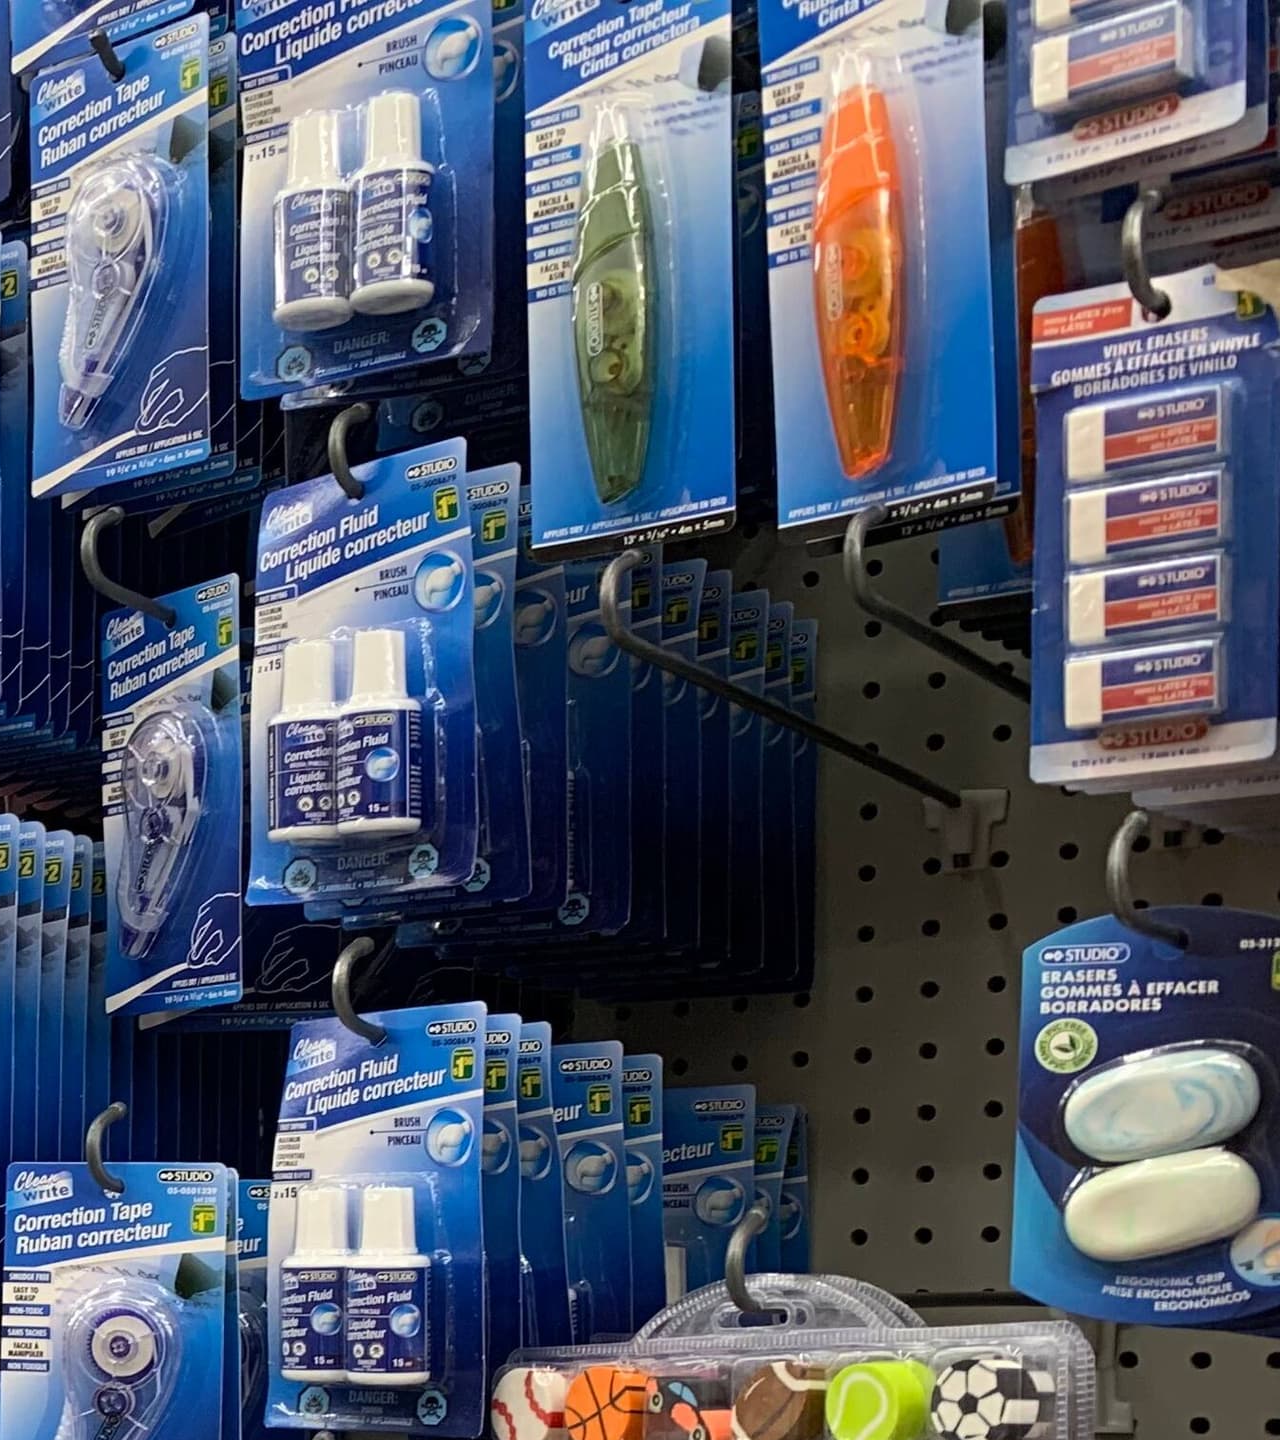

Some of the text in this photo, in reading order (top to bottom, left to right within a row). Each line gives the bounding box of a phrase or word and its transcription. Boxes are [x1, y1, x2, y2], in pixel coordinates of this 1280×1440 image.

[241, 1, 336, 56] Correction
[276, 23, 341, 64] Liquide
[387, 35, 418, 53] BRUSH
[549, 14, 625, 59] Correction
[562, 5, 690, 71] Ruban correcteur
[580, 15, 700, 79] Cinta correctora
[379, 54, 419, 75] PINCEAU
[39, 74, 149, 146] Correction Tape
[40, 90, 166, 169] Ruban correcteur
[1103, 327, 1208, 359] VINYL ERASERS
[1051, 333, 1260, 386] GOMMES VINYLE
[1073, 355, 1238, 399] BORRADORES VINILO
[1157, 397, 1205, 418] STUDIO
[420, 457, 456, 475] STUDIO
[1161, 482, 1208, 502] STUDIO
[260, 505, 378, 571] Correction Fluid
[285, 512, 430, 583] Liquide correcteur
[1158, 567, 1205, 586] STUDIO
[108, 625, 195, 679] Correction Tape
[1154, 653, 1202, 672] STUDIO
[110, 642, 207, 701] Ruban correcteur
[1065, 948, 1120, 963] STUDIO
[1041, 980, 1219, 999] GOMMES EFFACER
[1042, 969, 1117, 984] ERASERS
[1041, 998, 1162, 1014] BORRADORES
[441, 1021, 476, 1034] STUDIO
[285, 1055, 397, 1100] Correction Fluid
[573, 1060, 611, 1072] STUDIO
[305, 1066, 446, 1116] Liquide correcteur
[394, 1116, 421, 1128] BRUSH
[174, 1171, 211, 1182] STUDIO
[14, 1201, 153, 1233] Correction Tape
[16, 1222, 171, 1255] Ruban correcteur
[1102, 1285, 1134, 1297] PRISE
[1154, 1289, 1250, 1311] ERGONÓMICOS
